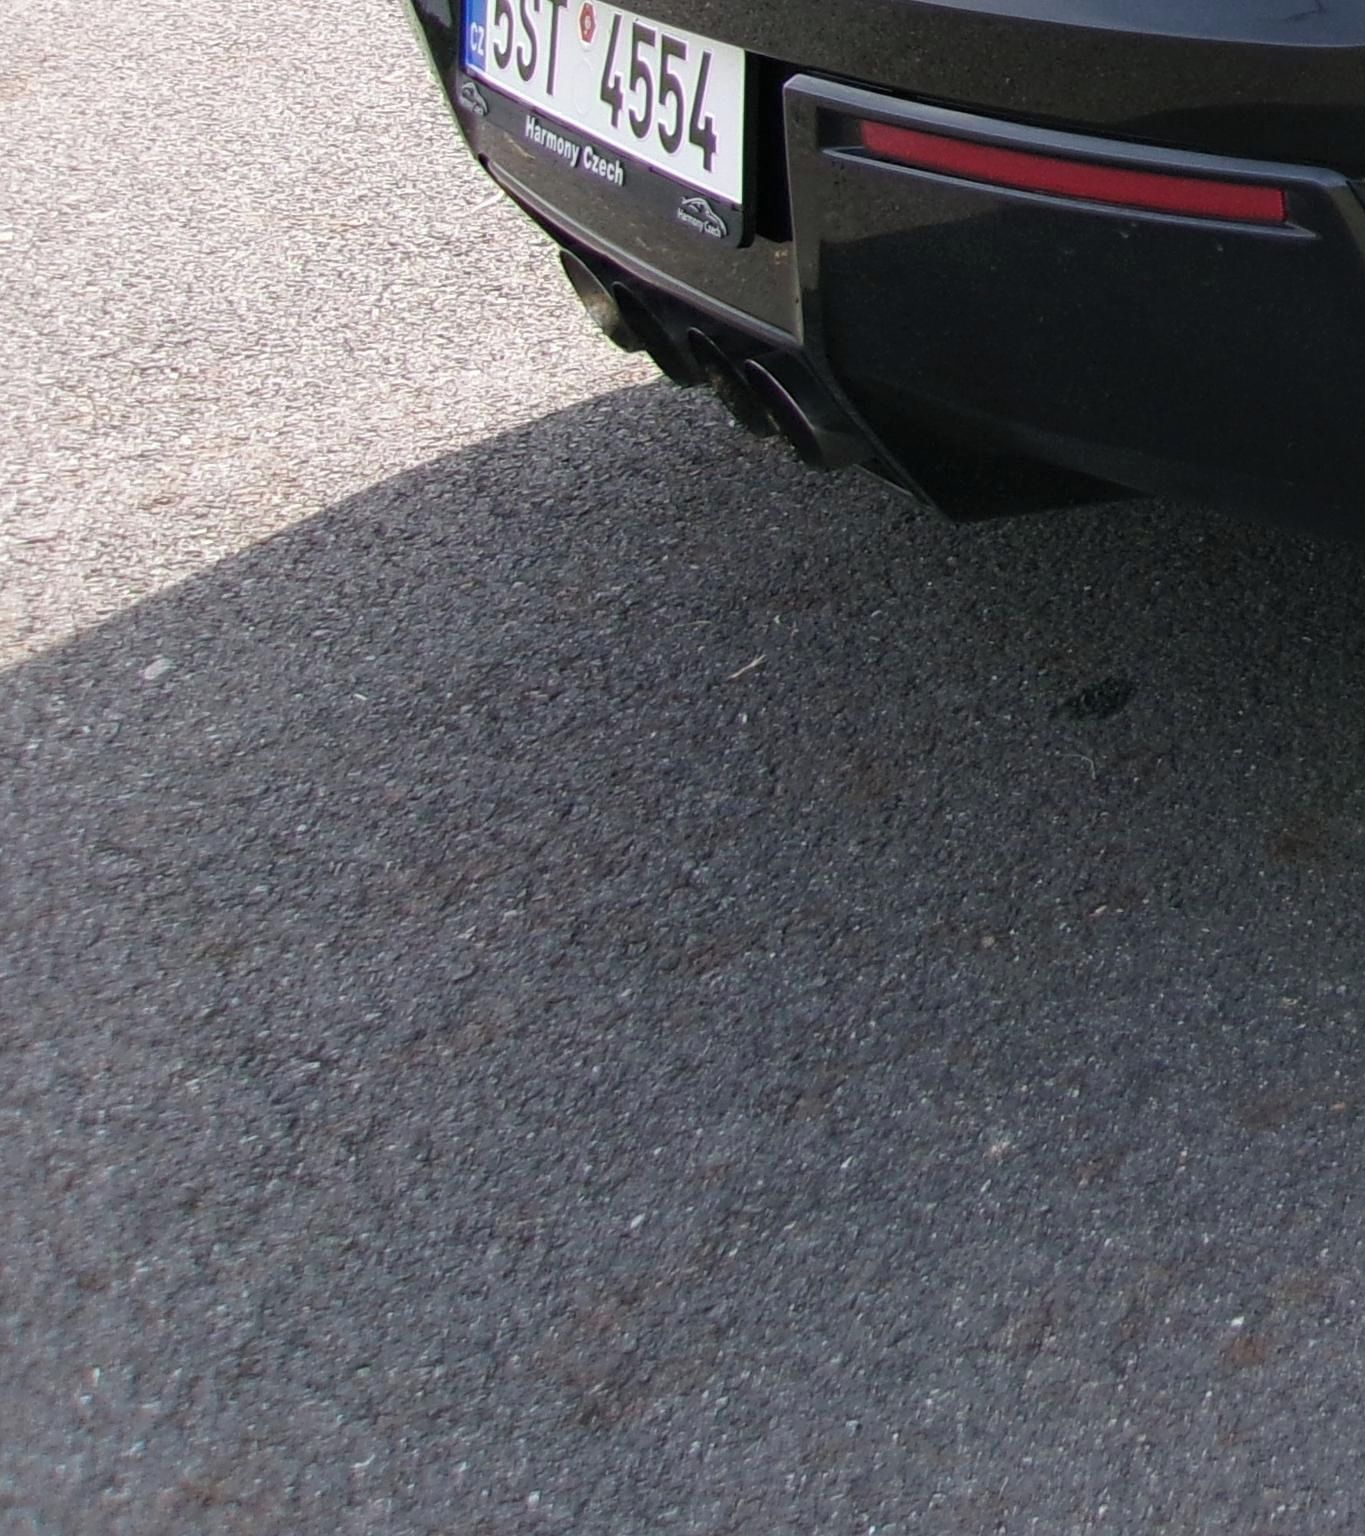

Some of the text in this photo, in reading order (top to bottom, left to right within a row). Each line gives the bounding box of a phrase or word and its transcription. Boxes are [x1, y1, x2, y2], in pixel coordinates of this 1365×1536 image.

[470, 22, 485, 57] CZ
[600, 13, 717, 173] 4554
[525, 115, 624, 187] Harmony Czech
